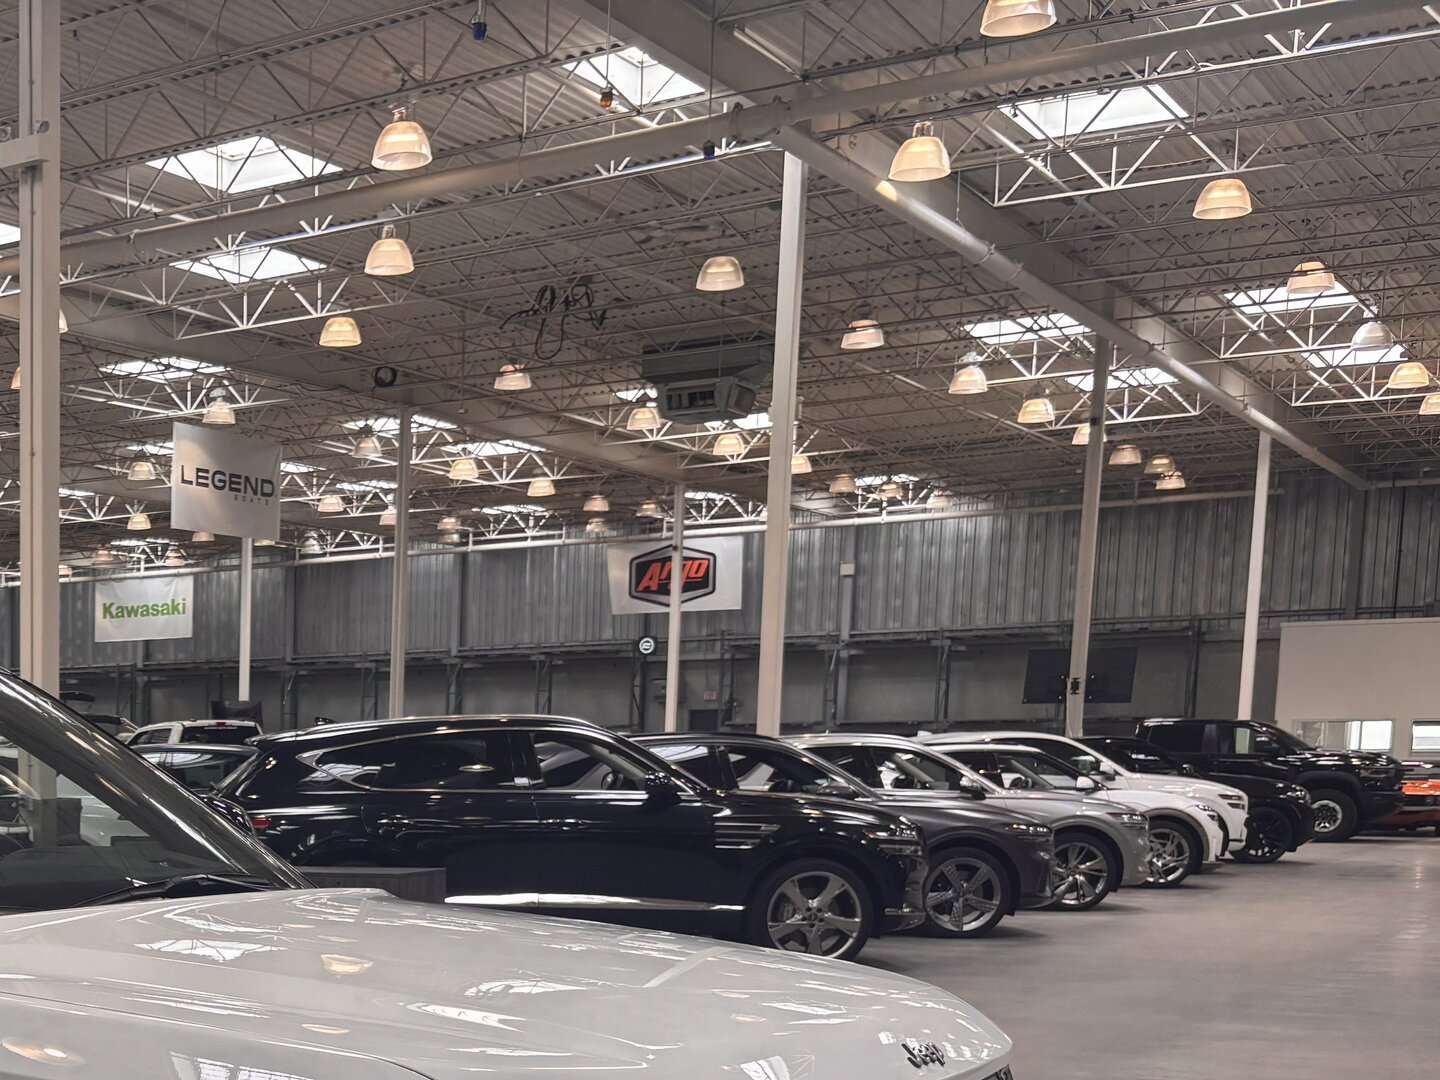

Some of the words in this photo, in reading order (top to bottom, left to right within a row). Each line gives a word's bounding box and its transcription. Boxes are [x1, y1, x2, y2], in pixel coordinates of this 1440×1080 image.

[181, 464, 275, 498] LEGEND
[102, 598, 187, 620] Kawasaki
[901, 1042, 946, 1069] Jeep
